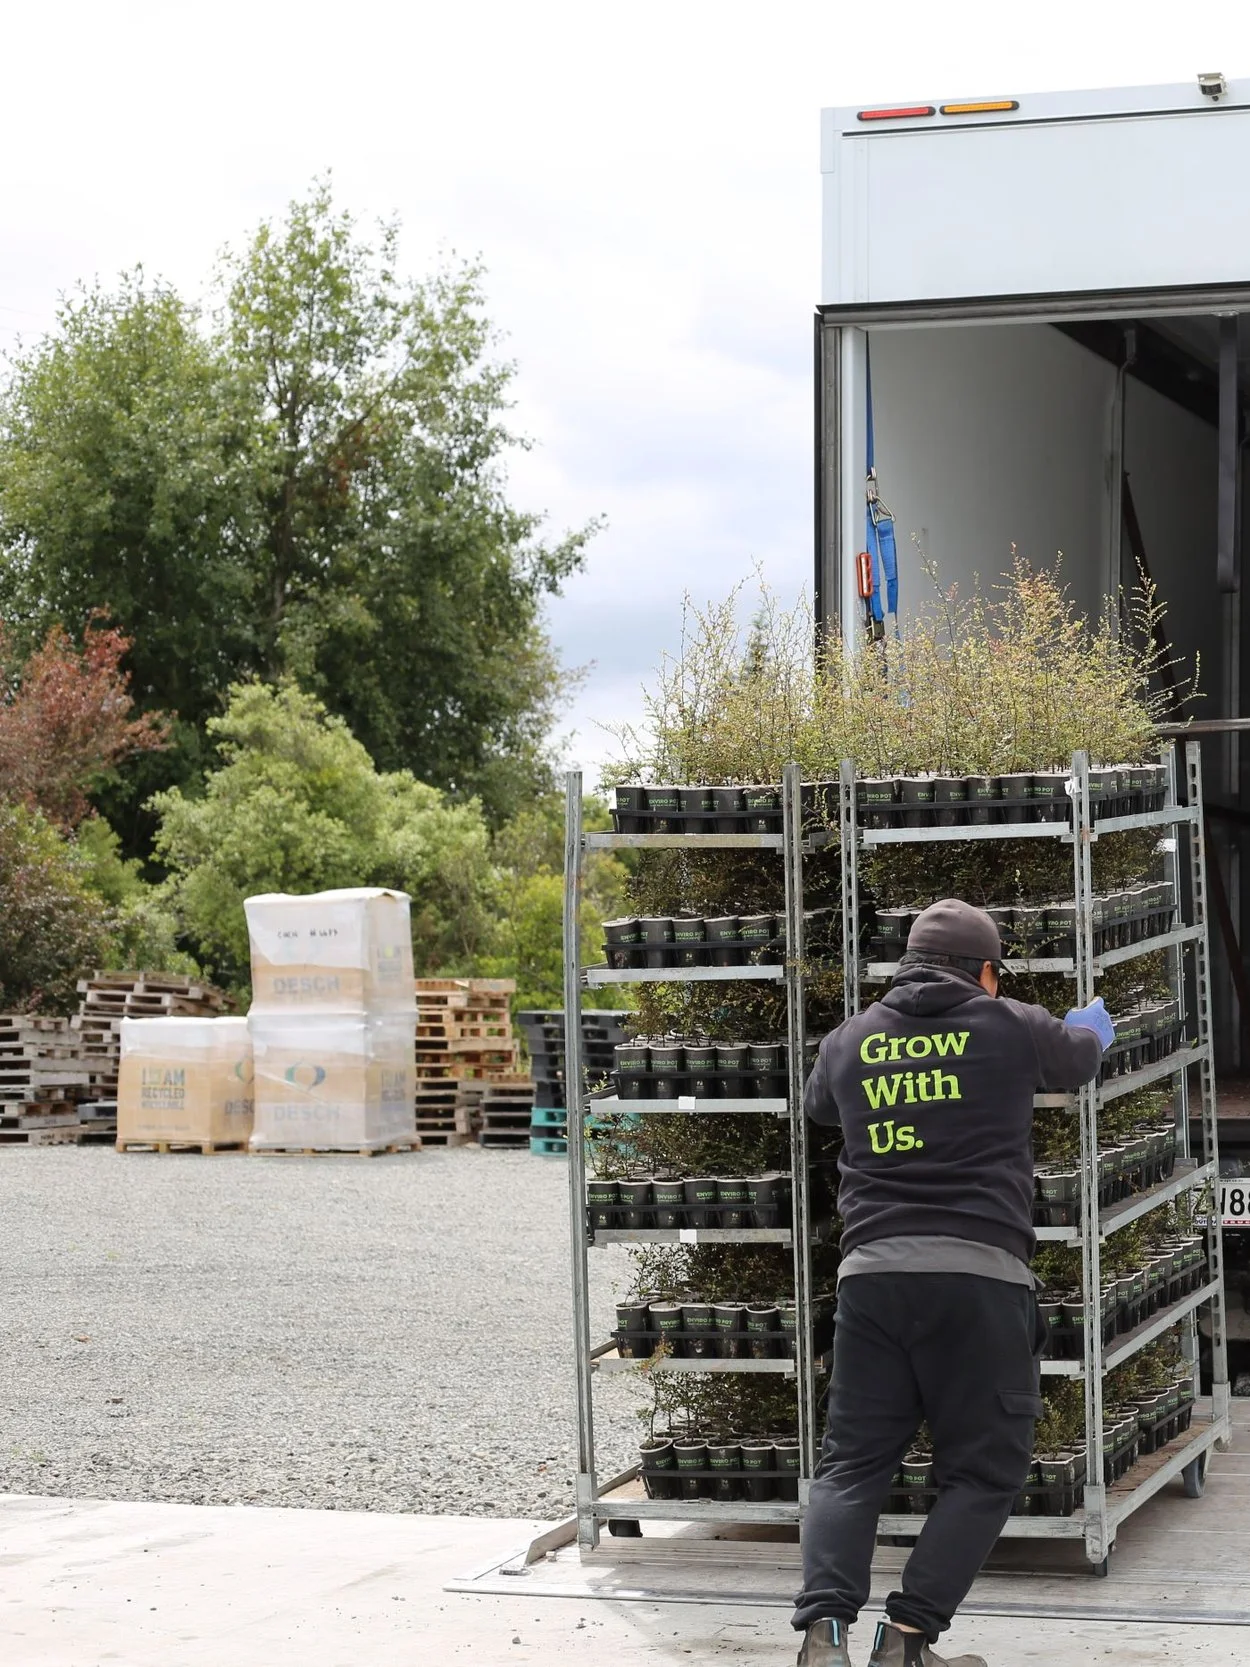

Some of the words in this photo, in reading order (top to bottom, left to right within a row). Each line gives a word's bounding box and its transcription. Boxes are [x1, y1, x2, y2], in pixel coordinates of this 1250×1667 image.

[273, 975, 341, 995] DESCH
[860, 1032, 970, 1064] Grow
[861, 1069, 962, 1110] With
[867, 1120, 924, 1154] Us.
